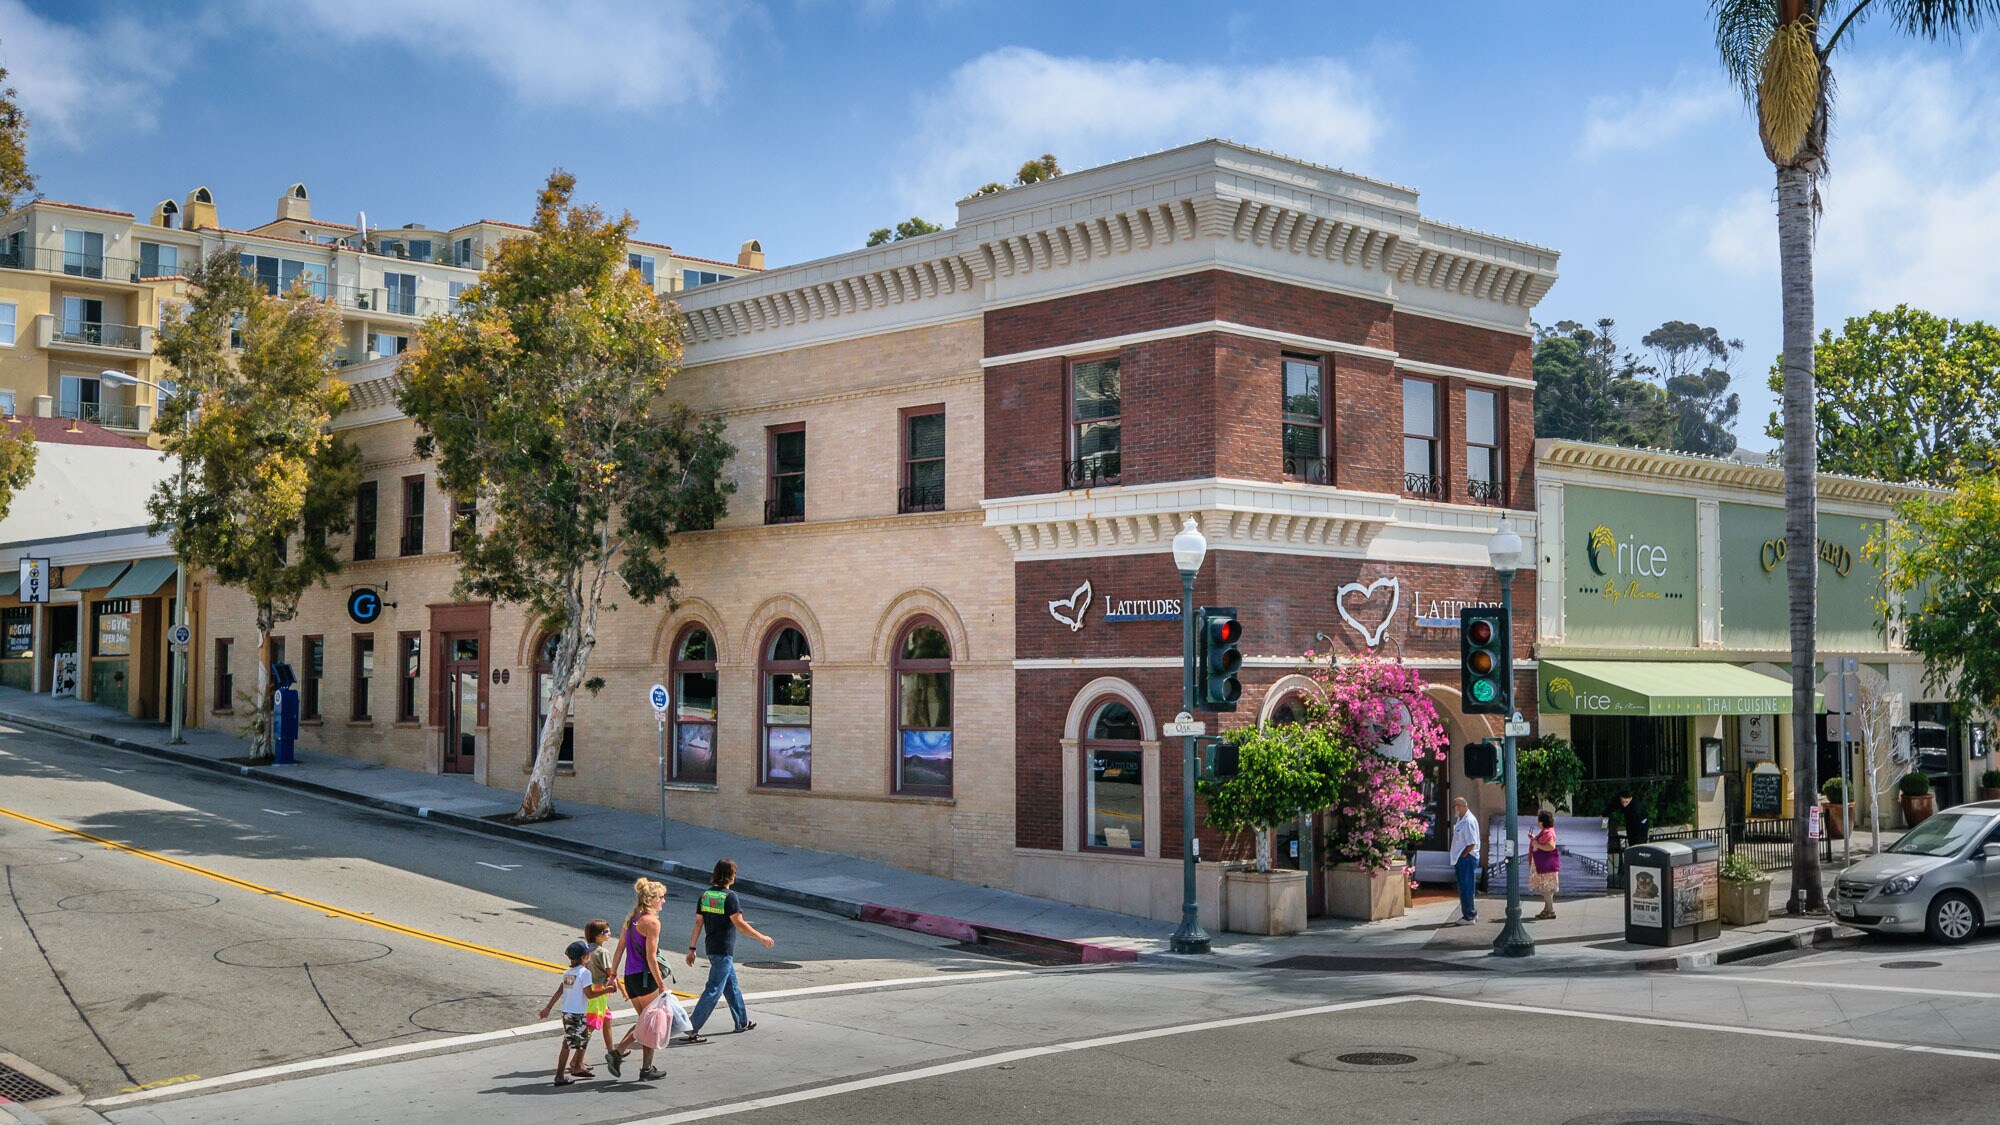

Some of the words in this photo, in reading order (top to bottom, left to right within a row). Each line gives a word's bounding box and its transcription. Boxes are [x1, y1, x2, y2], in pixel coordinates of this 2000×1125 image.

[1617, 533, 1668, 577] rice
[1761, 538, 1854, 577] COARD
[1601, 578, 1619, 605] By
[353, 594, 376, 618] G
[1104, 595, 1181, 616] LATITUDES
[1575, 691, 1611, 710] rice
[1706, 697, 1732, 712] THAI
[1737, 697, 1777, 712] CUISINE
